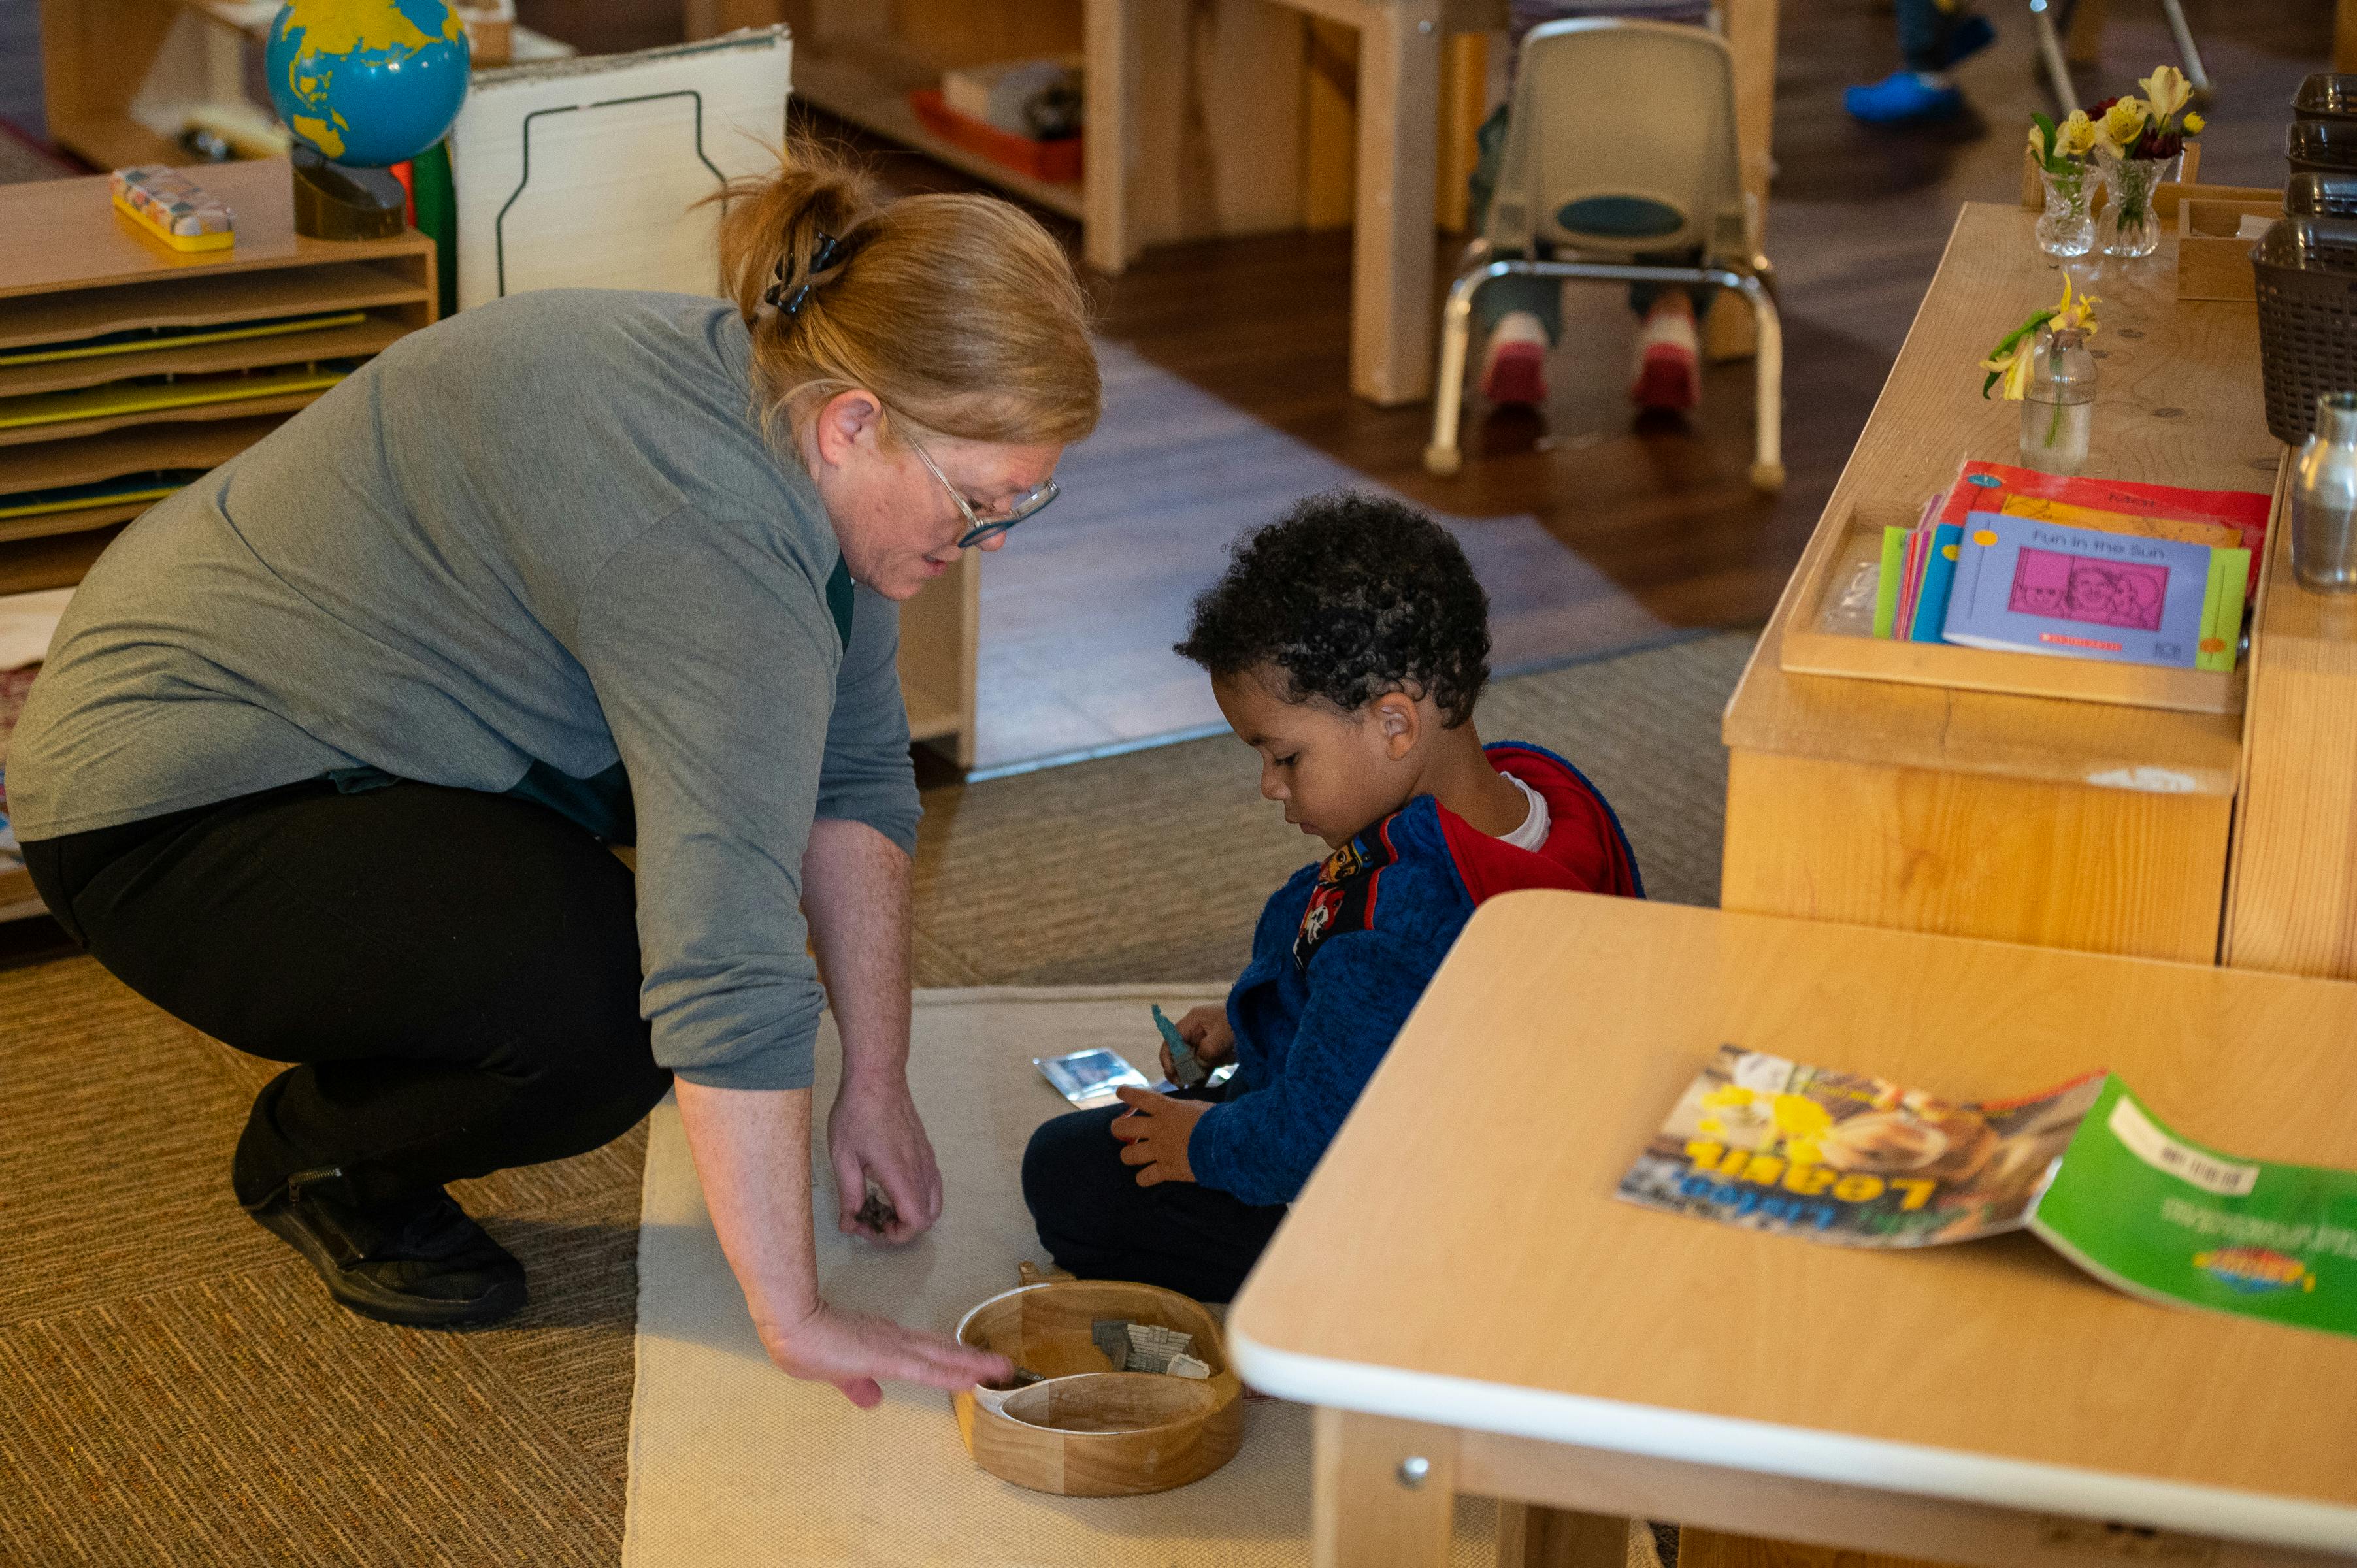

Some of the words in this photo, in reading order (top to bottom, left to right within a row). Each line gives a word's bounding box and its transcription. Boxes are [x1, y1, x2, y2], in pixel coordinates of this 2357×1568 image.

[2033, 528, 2067, 546] Fun
[2071, 533, 2088, 550] in
[2094, 538, 2125, 555] the
[2131, 542, 2165, 559] Sun
